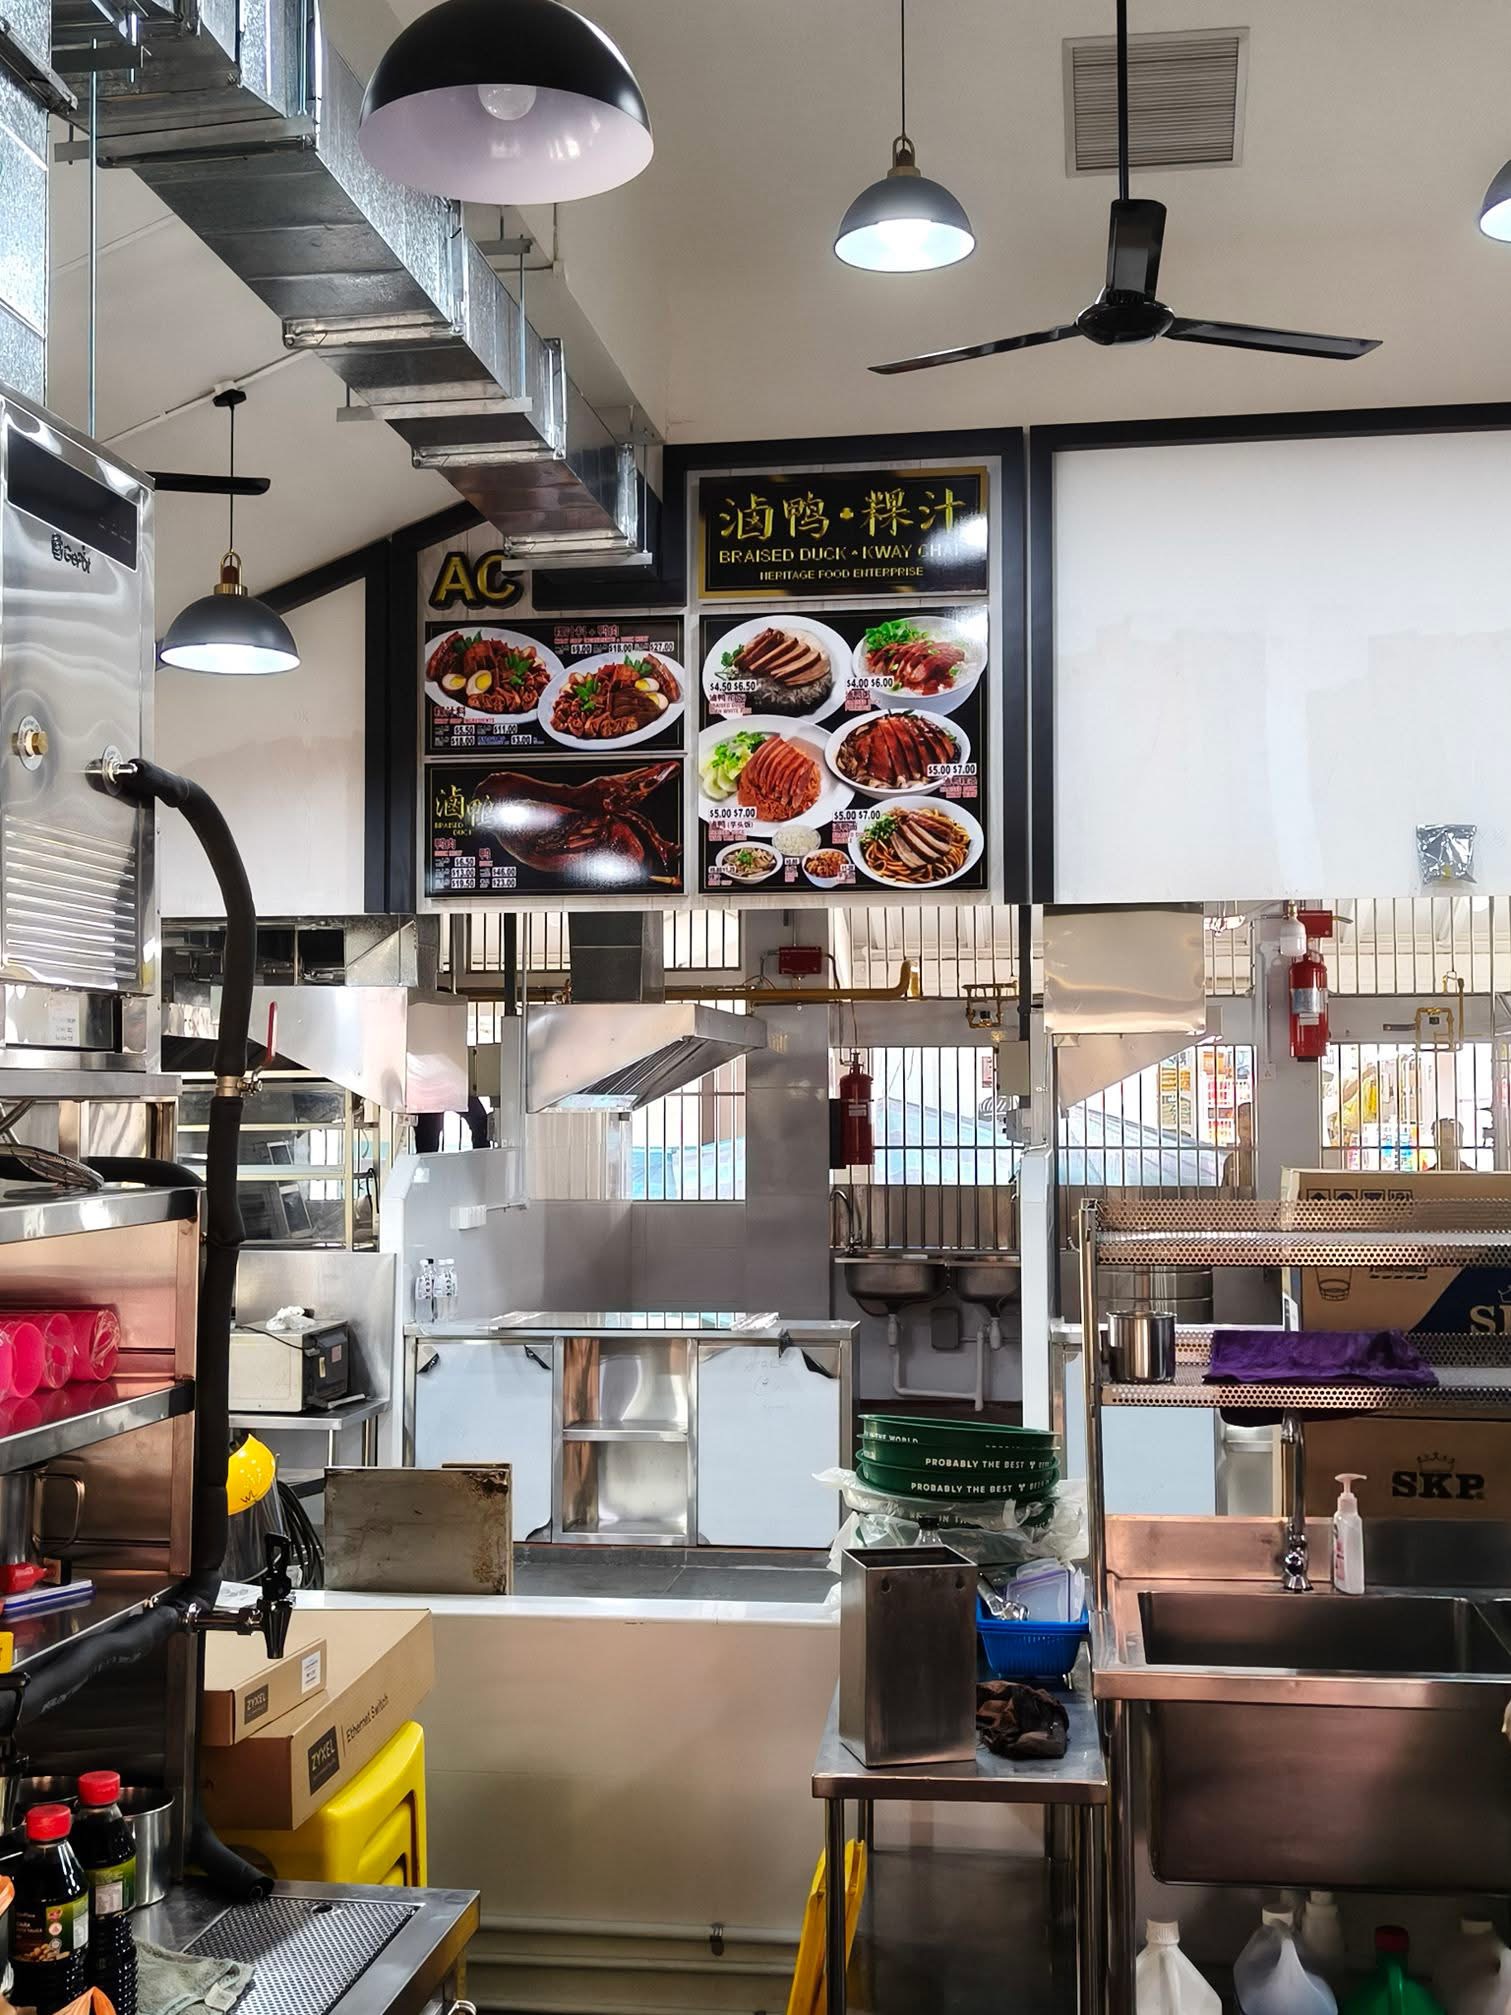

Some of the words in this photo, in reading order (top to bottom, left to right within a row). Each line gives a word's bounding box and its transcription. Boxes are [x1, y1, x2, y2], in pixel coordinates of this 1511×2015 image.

[719, 548, 795, 563] BRAISED
[800, 546, 847, 562] DUCK
[862, 544, 913, 560] KWAY
[431, 552, 520, 606] AC
[759, 568, 816, 581] HERITAGE
[818, 568, 851, 580] FOOD
[853, 566, 924, 579] ENTERPRISE
[710, 682, 732, 692] $4.50
[734, 681, 756, 691] $6.50
[846, 679, 869, 688] $4.00
[871, 678, 893, 688] $6.00
[928, 765, 951, 775] $5.00
[953, 764, 976, 774] $7.00
[709, 808, 732, 818] $5.00
[734, 808, 756, 818] $7.00
[834, 810, 857, 820] $5.00
[858, 810, 881, 820] $7.00
[925, 1457, 979, 1469] PROBABLY
[982, 1460, 1001, 1469] THE
[1004, 1460, 1025, 1469] BEST
[911, 1482, 963, 1494] PROBABLY
[966, 1485, 986, 1494] THE
[989, 1484, 1012, 1494] BEST
[311, 1738, 336, 1772] ZYXEL
